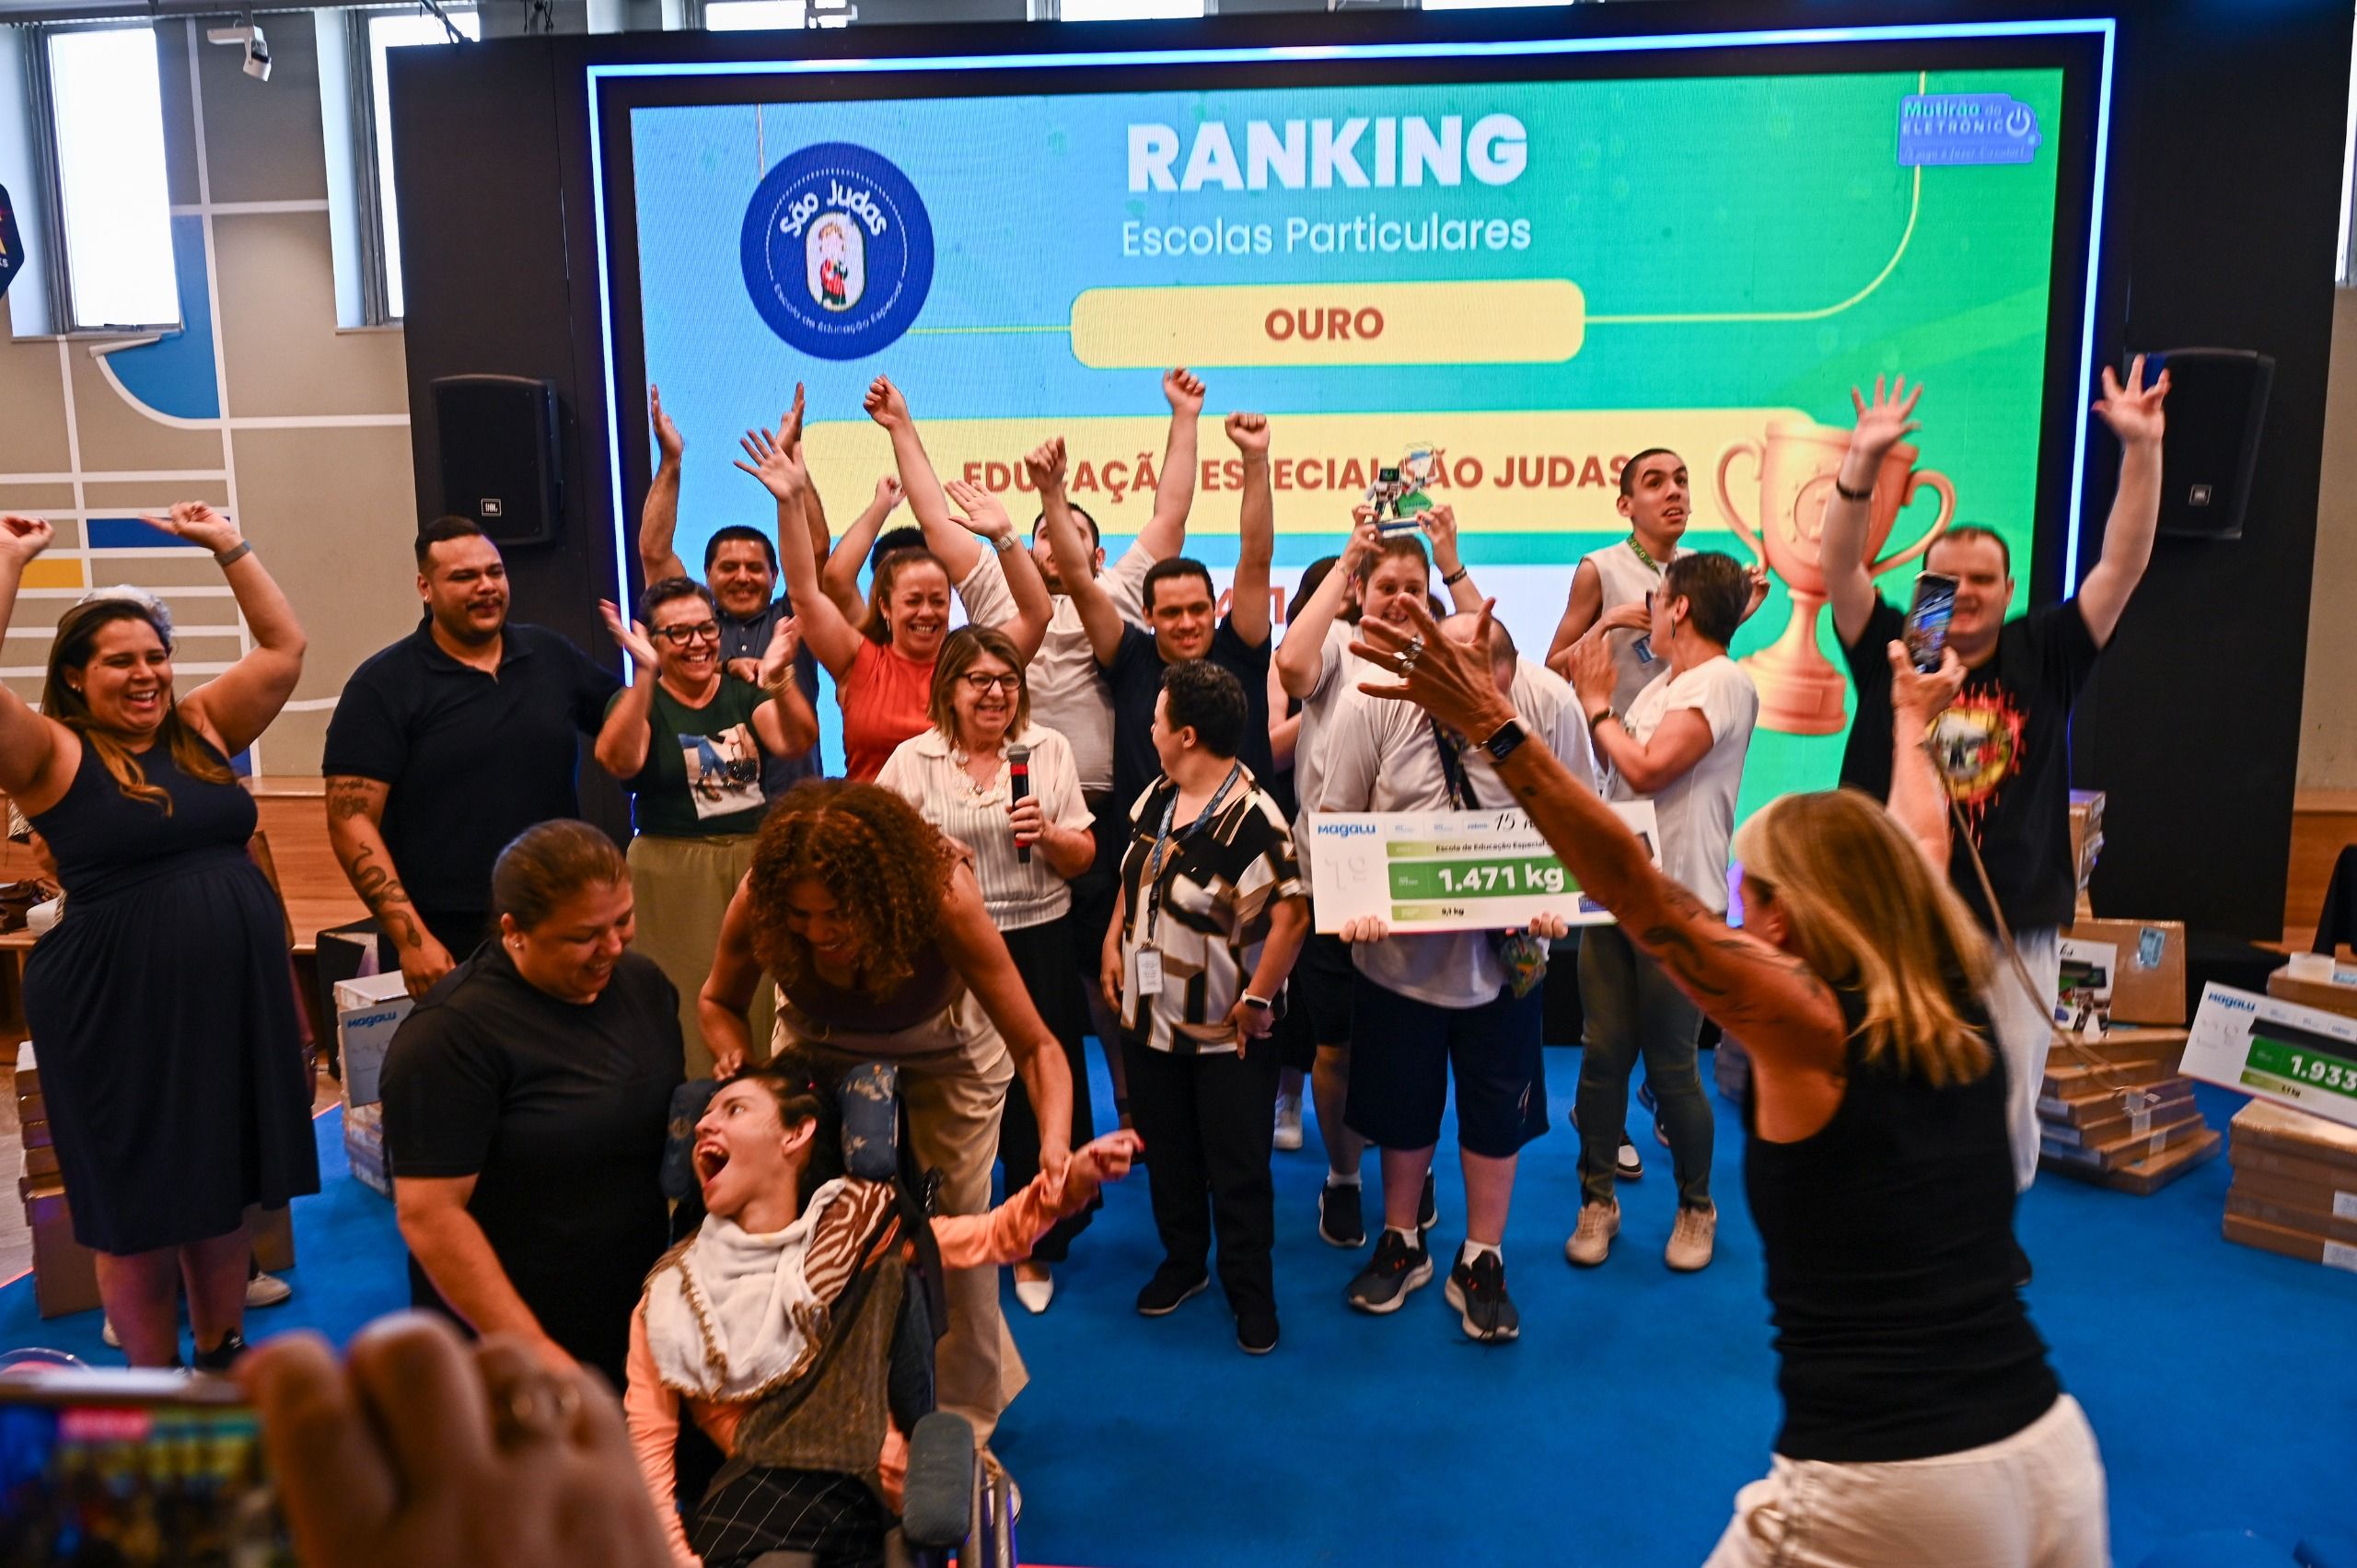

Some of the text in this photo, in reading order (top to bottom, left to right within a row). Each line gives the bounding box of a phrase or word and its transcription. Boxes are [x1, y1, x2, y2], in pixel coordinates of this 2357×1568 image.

[1127, 113, 1527, 192] RANKING
[779, 179, 888, 238] São Judas
[1122, 212, 1531, 257] Escolas Particulares
[1264, 306, 1385, 341] OURO
[963, 450, 1159, 504] EDUAÇÃ
[1435, 842, 1461, 853] Escola
[1513, 839, 1545, 850] Especial
[1438, 864, 1564, 892] 1.471 kg
[2291, 1055, 2357, 1093] 1.933
